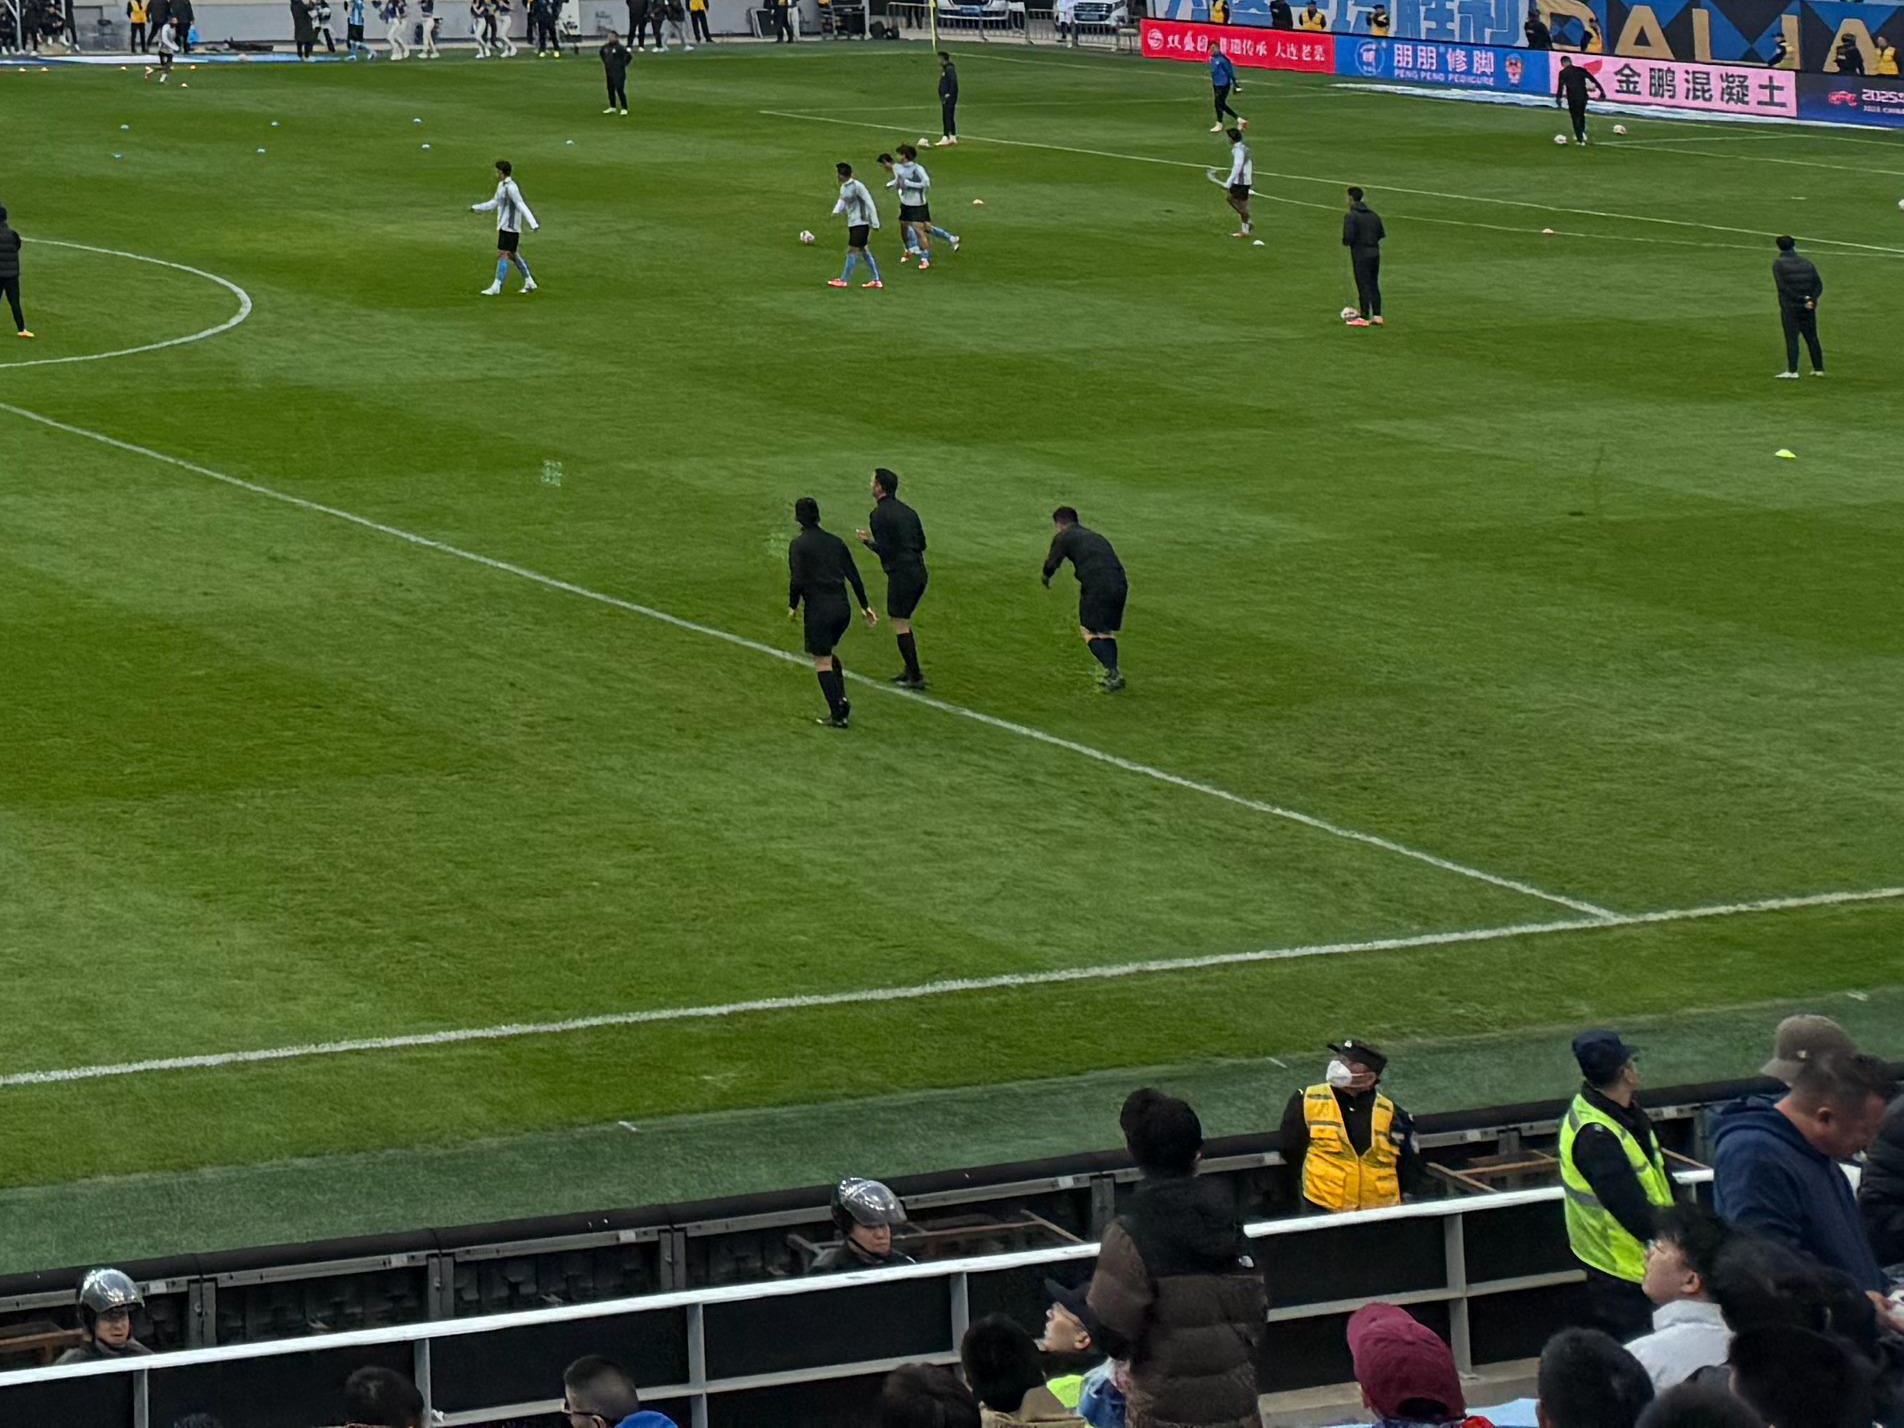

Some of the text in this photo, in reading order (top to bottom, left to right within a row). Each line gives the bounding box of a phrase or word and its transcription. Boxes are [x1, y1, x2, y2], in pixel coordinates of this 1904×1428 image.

[1614, 62, 1788, 109] 金鹏混凝土
